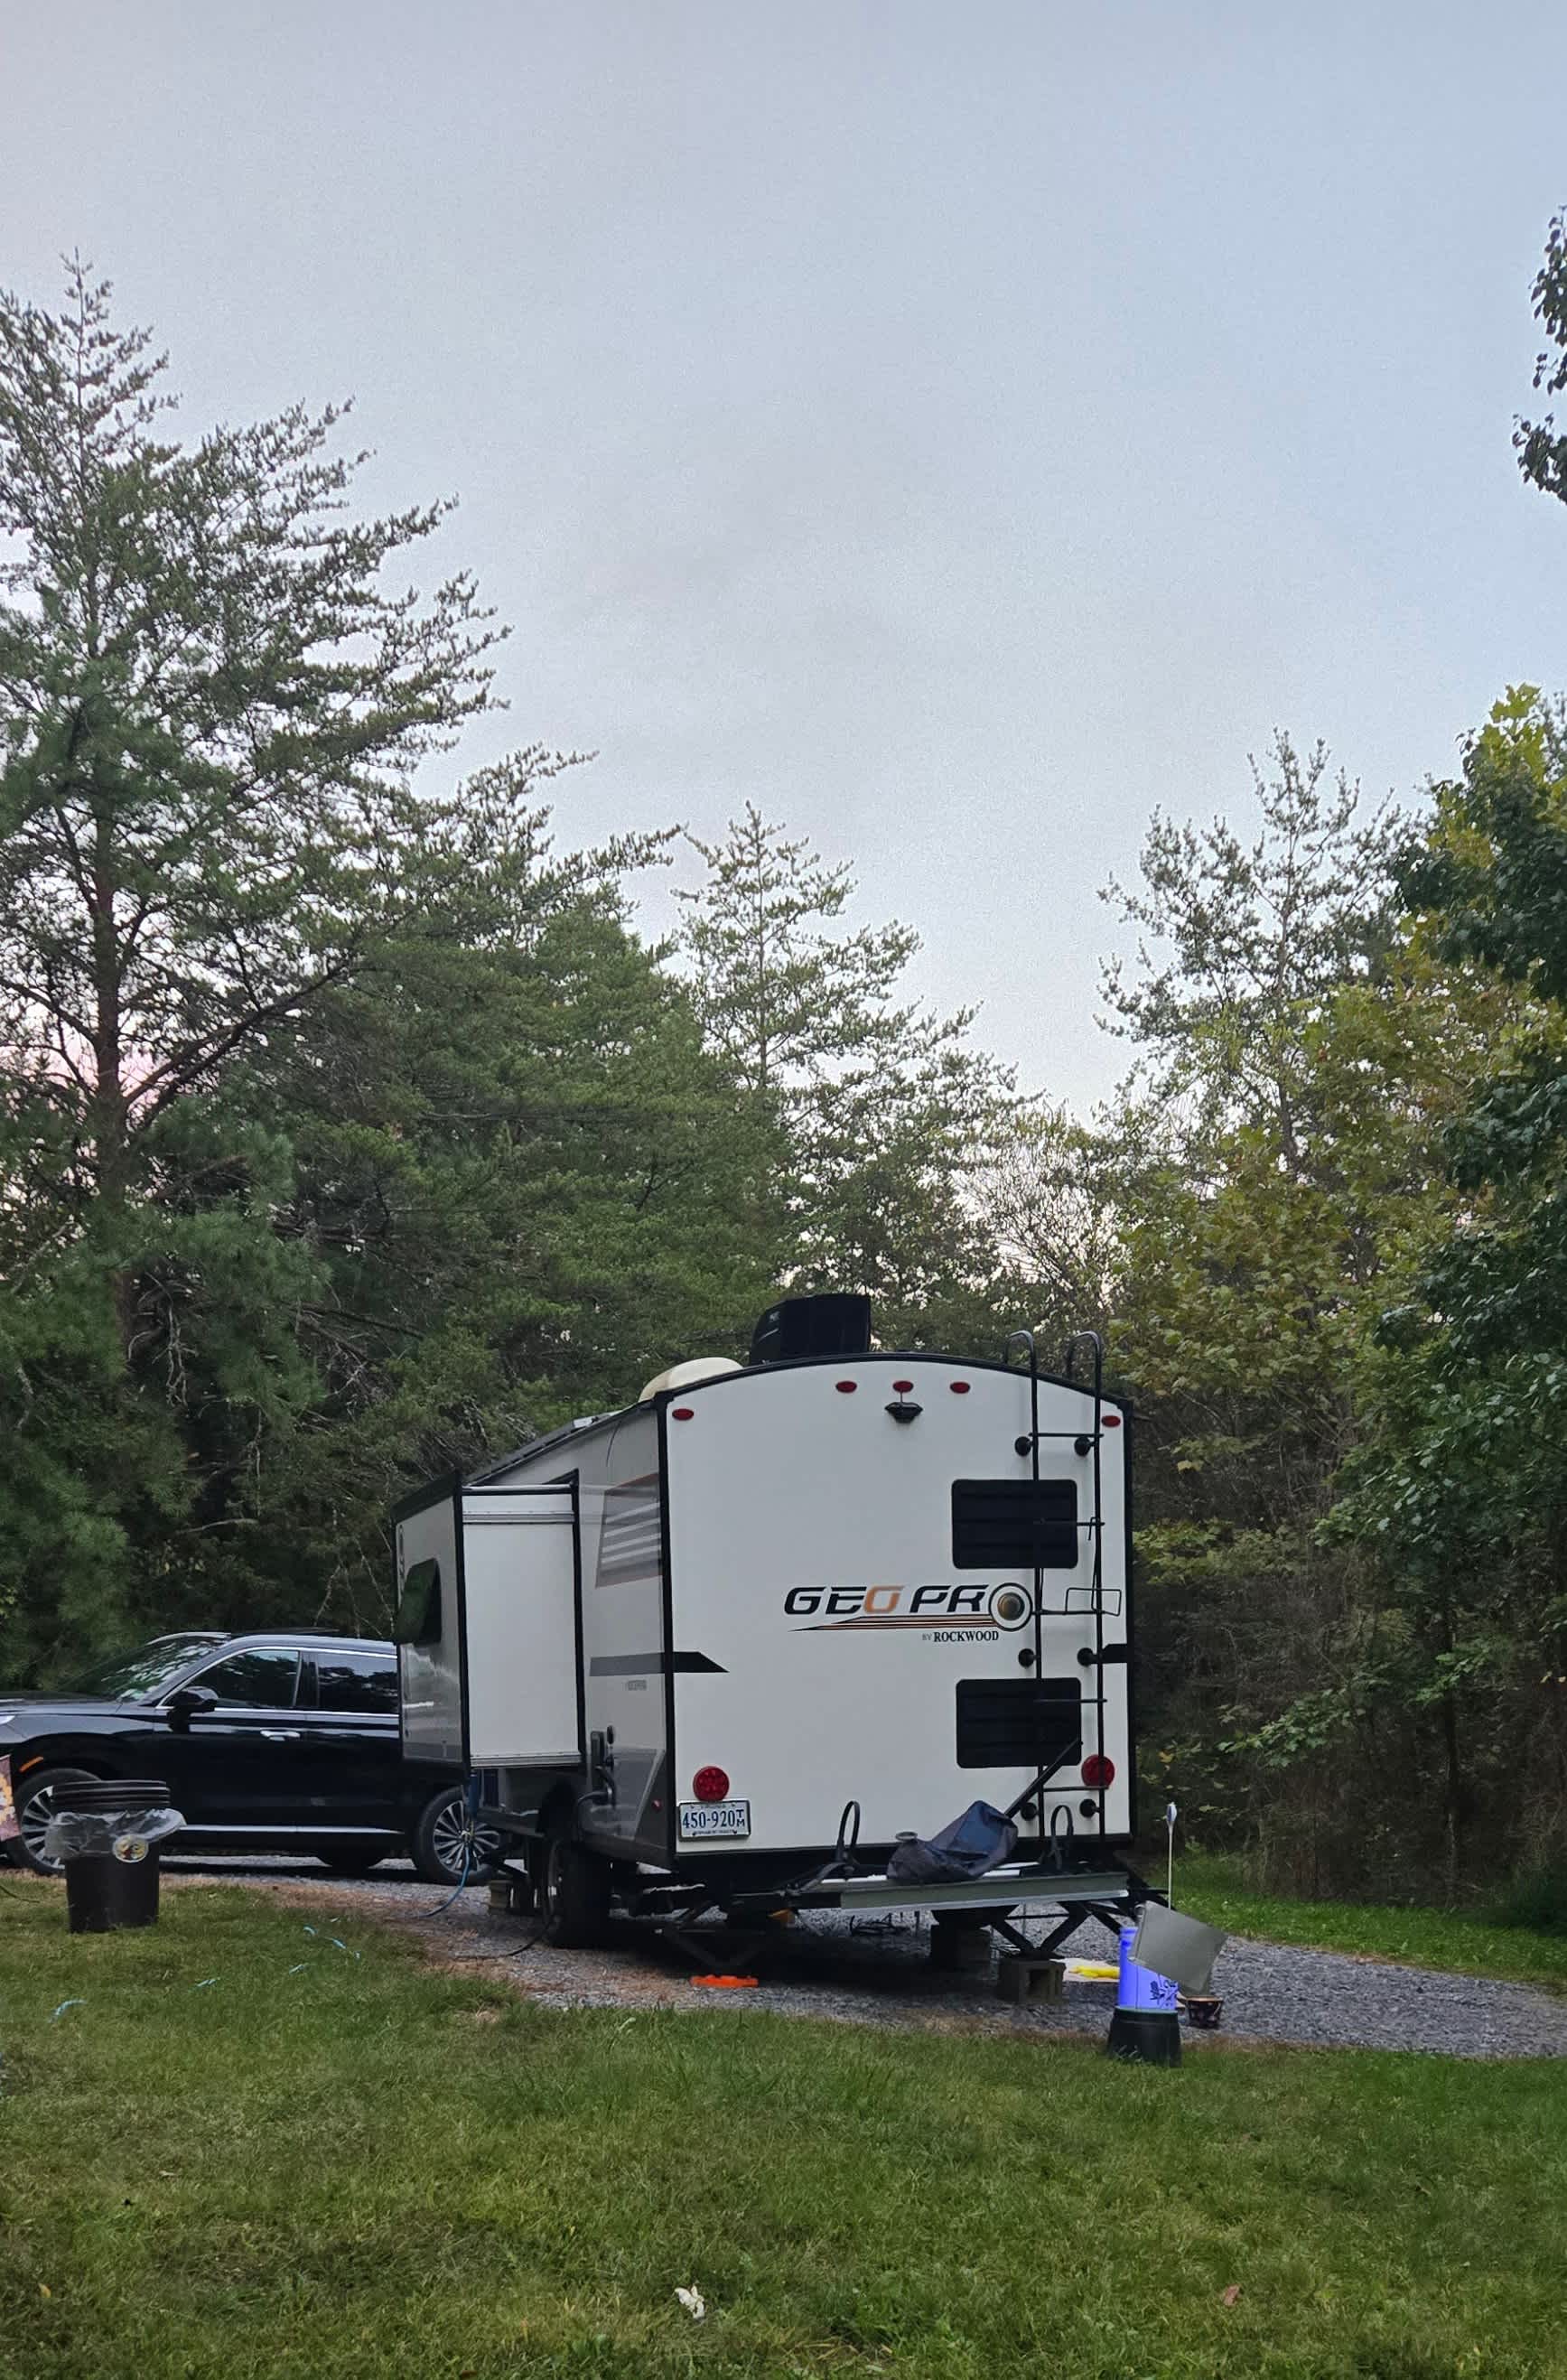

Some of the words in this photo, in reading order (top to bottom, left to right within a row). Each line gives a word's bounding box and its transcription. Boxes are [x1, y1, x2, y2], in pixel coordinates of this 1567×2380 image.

[784, 1586, 903, 1614] GEO
[909, 1582, 1033, 1631] PRO
[922, 1633, 932, 1641] BY
[934, 1630, 999, 1642] ROCKWOOD
